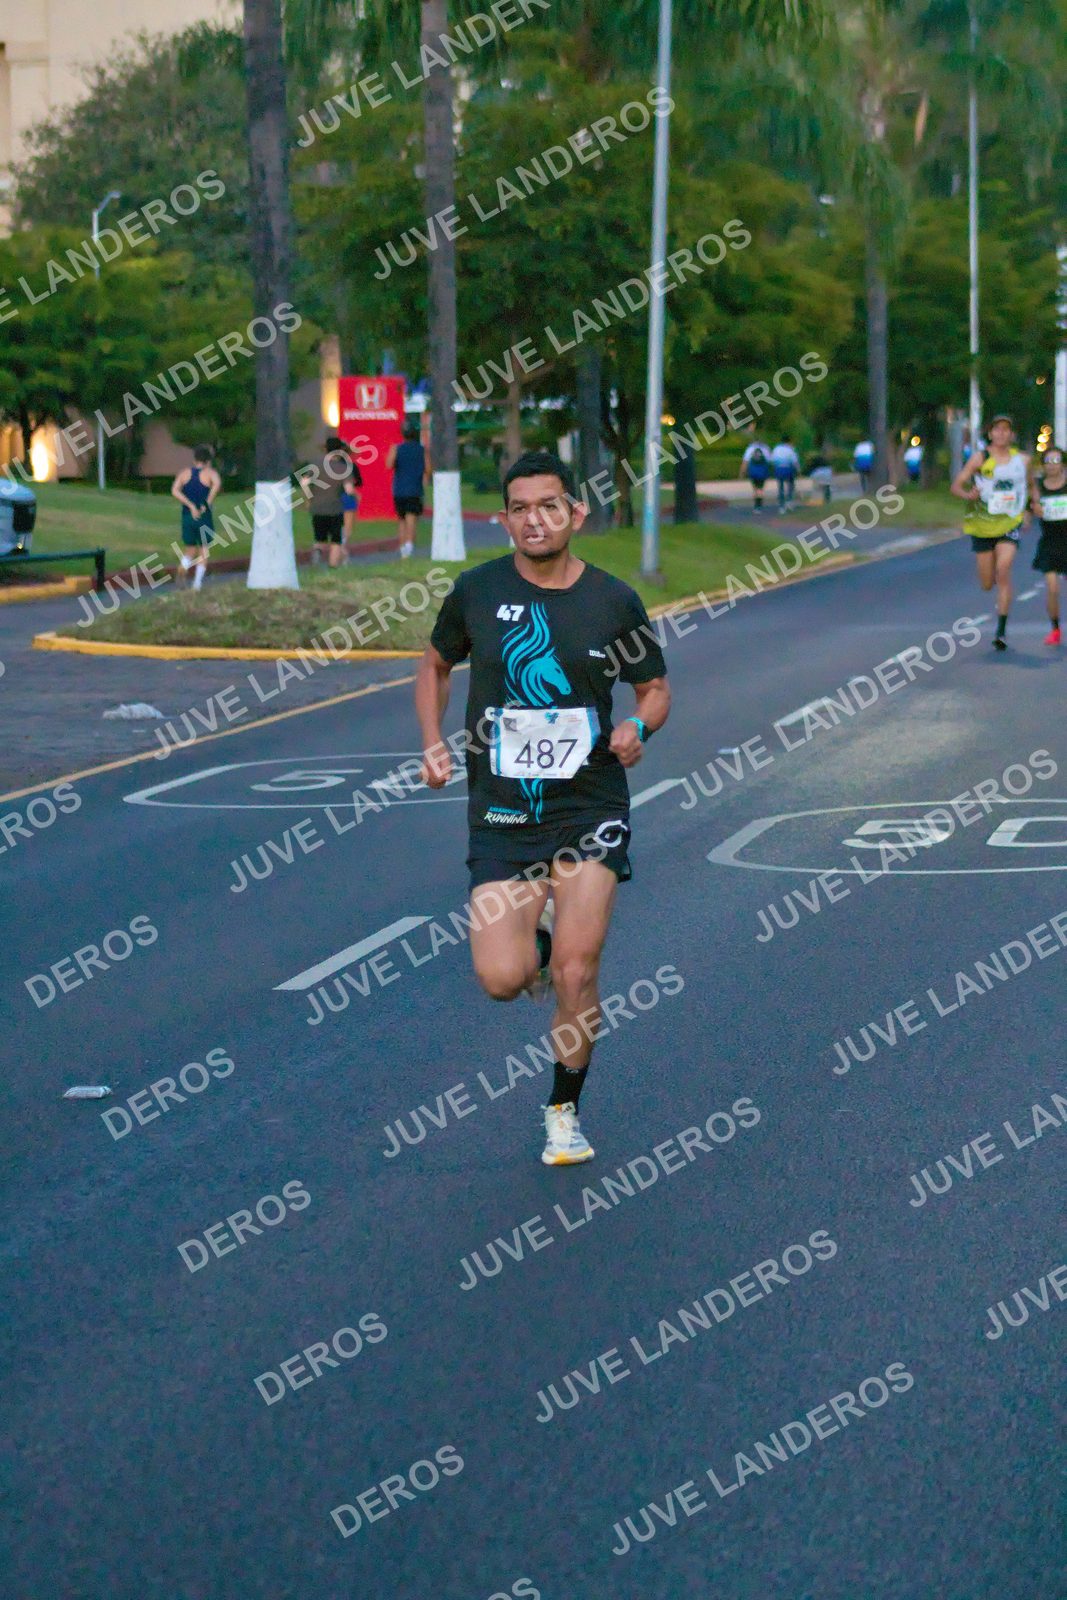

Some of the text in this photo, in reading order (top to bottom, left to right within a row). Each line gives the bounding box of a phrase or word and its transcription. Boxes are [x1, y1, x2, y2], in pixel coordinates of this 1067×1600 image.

[344, 410, 398, 421] HONDA
[496, 604, 525, 621] 47
[514, 739, 578, 768] 487
[484, 811, 529, 825] RUNNING
